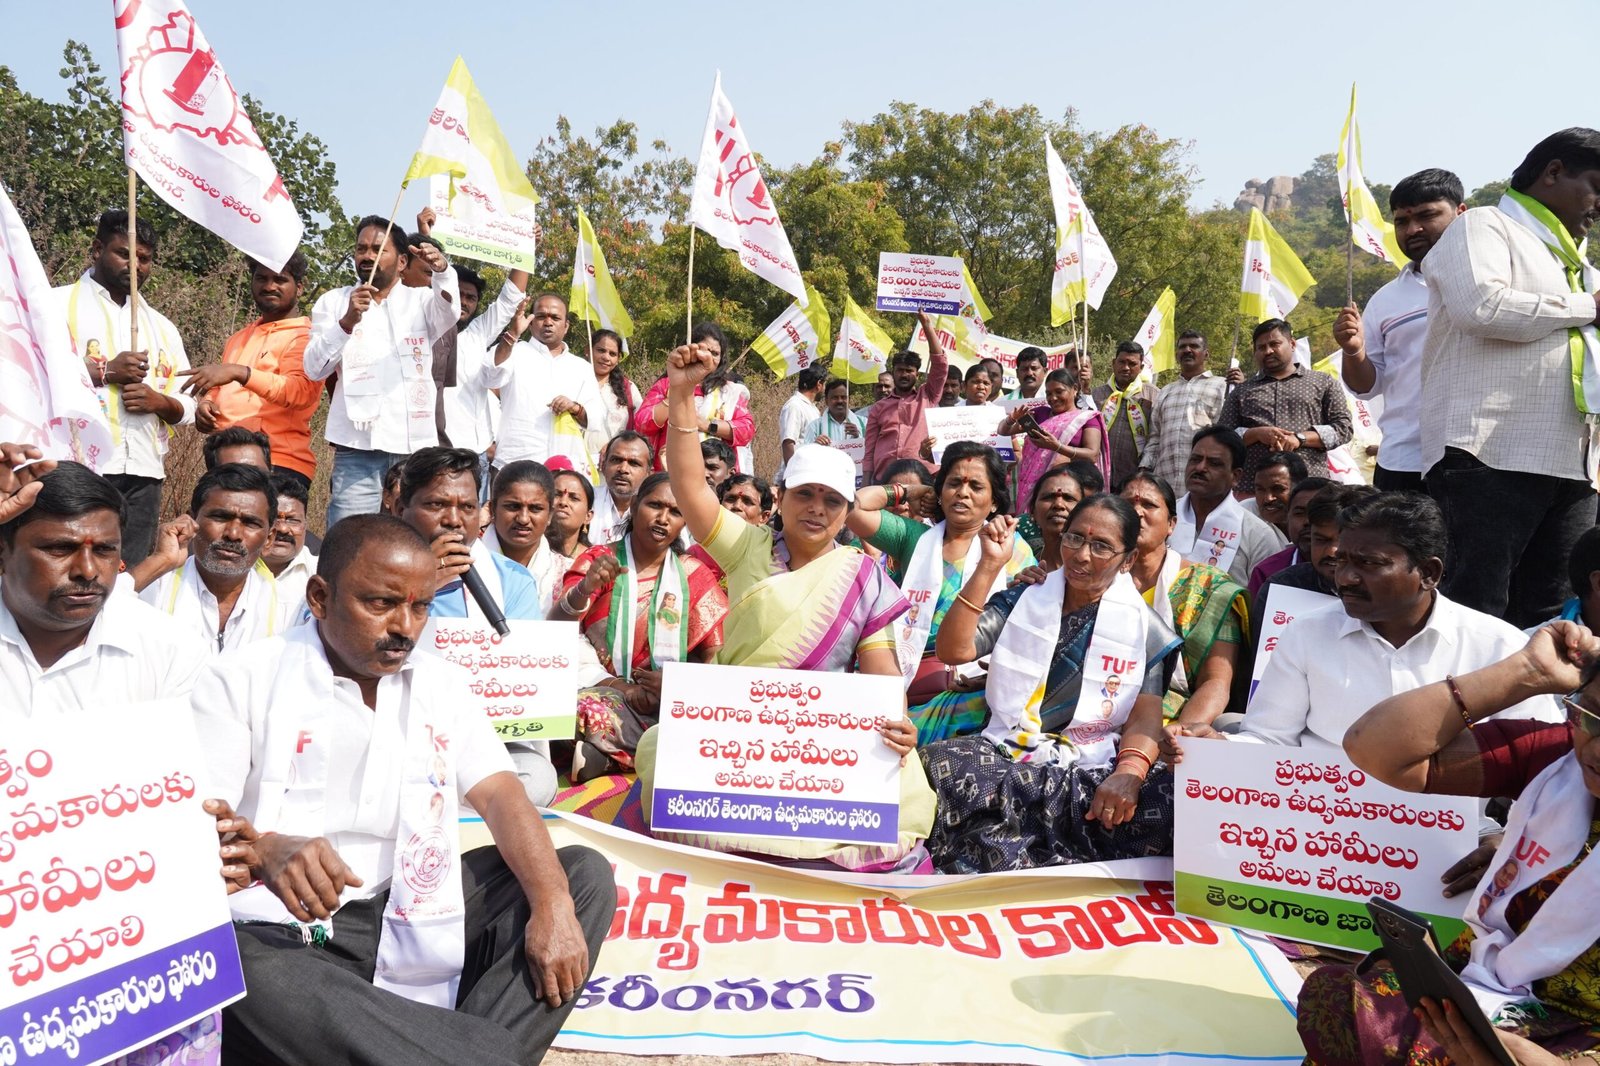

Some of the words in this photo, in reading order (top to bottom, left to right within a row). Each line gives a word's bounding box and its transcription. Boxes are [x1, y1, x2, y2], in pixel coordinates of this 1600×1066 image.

[404, 337, 425, 346] TUF
[1211, 527, 1238, 541] TUF
[907, 589, 932, 603] TUF
[1102, 655, 1137, 675] TUF
[749, 680, 822, 706] ప్రభుత్వం
[670, 701, 753, 724] తెలంగాణ
[699, 739, 765, 769] ఇచ్చిన
[770, 738, 859, 767] హామీలు
[714, 770, 774, 789] అమలు
[778, 770, 845, 795] చేయాలి
[1275, 759, 1366, 793] ప్రభుత్వం
[667, 793, 721, 819] కరీంనగర్
[720, 800, 772, 821] తెలంగాణ
[773, 802, 847, 832] ఉద్యమకారుల
[848, 811, 881, 831] ఫోరం
[1185, 778, 1280, 809] తెలంగాణ
[1285, 788, 1465, 832] ఉద్యమకారులకు
[1218, 821, 1298, 860] ఇచ్చిన
[1305, 830, 1419, 871] హామీలు
[1239, 859, 1312, 887] అమలు
[1316, 866, 1402, 901] చేయాలి
[1205, 885, 1330, 927] తెలంగాణ
[9, 914, 145, 988] చేయాలి
[18, 974, 167, 1060] ఉద్యమకారుల
[166, 948, 218, 1003] ఫోరం
